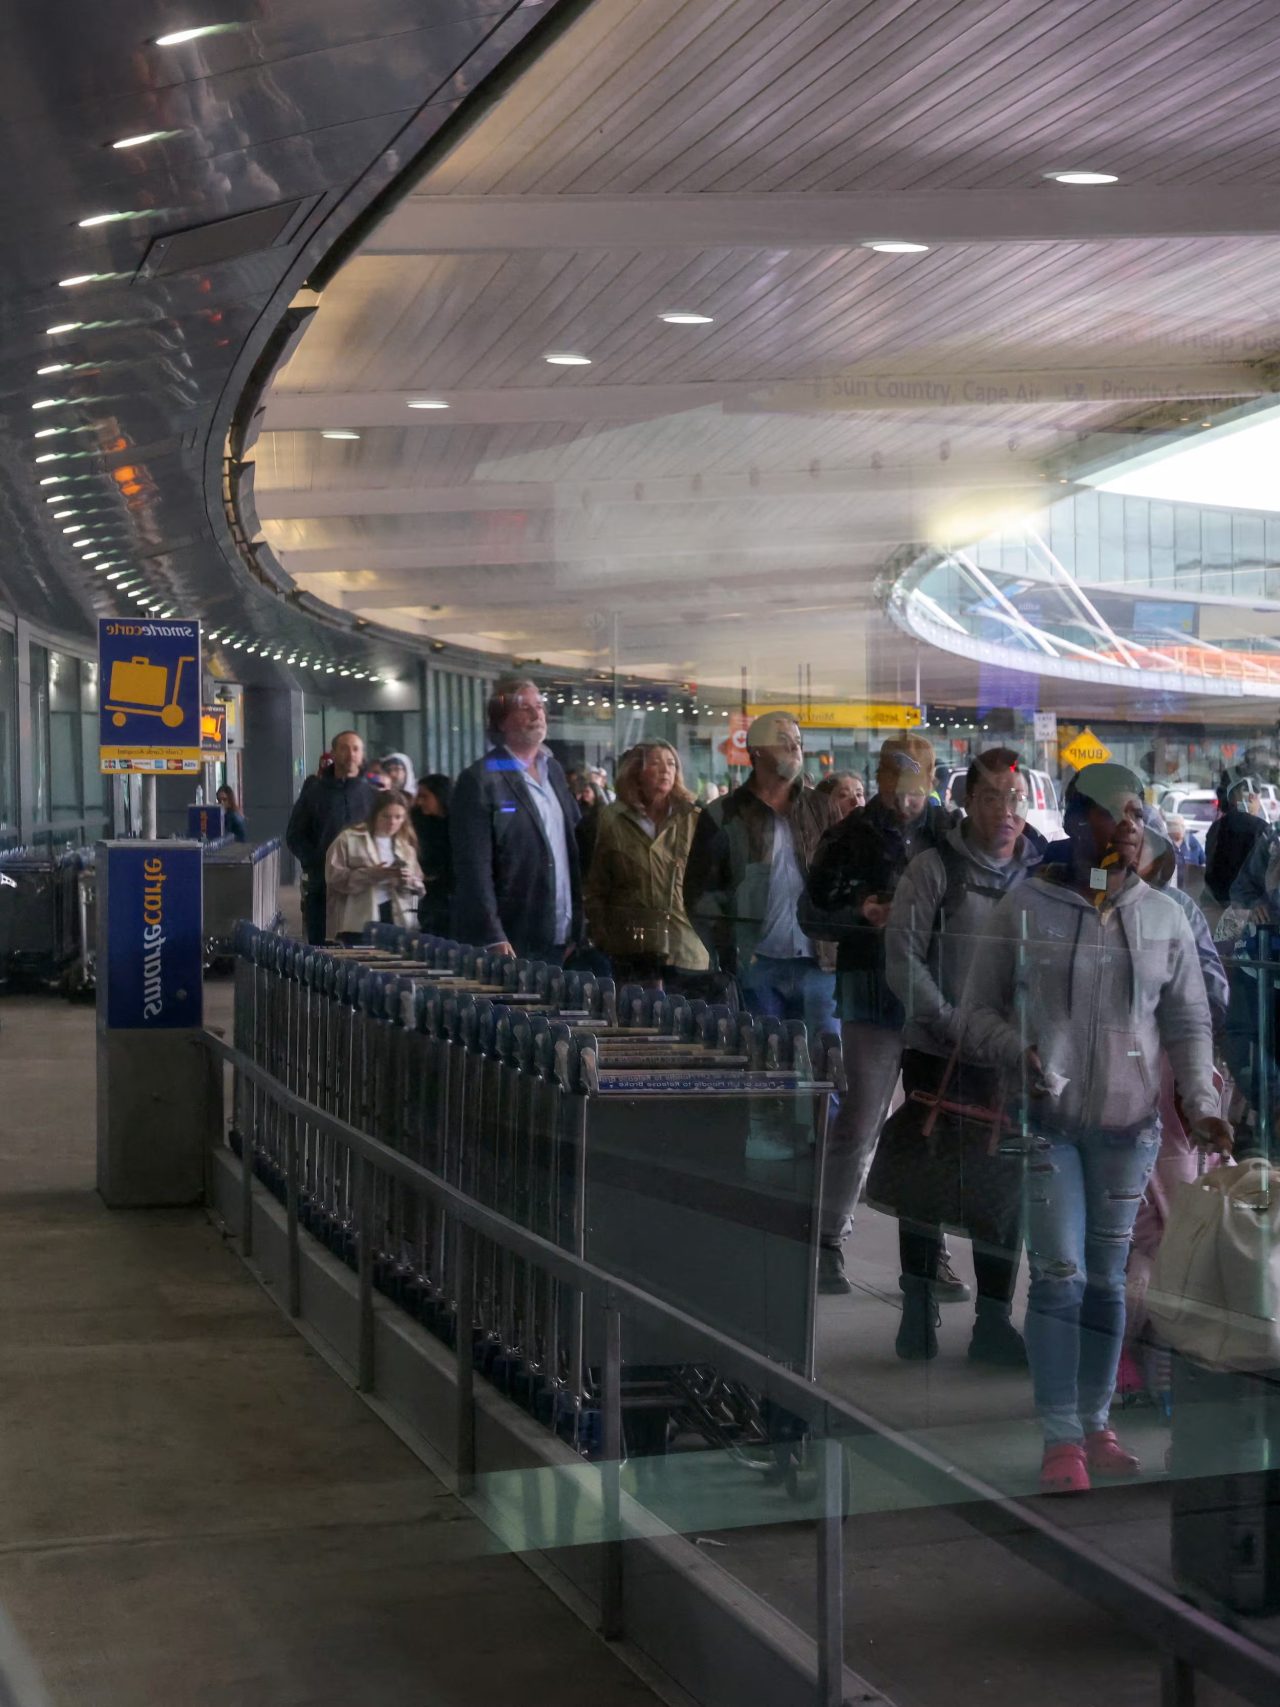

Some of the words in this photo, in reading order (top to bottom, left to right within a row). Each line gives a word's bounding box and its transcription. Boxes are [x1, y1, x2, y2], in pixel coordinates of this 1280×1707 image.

[832, 378, 867, 396] Sun
[875, 380, 954, 406] Country,
[962, 380, 1008, 406] Cape
[1016, 382, 1043, 402] Air
